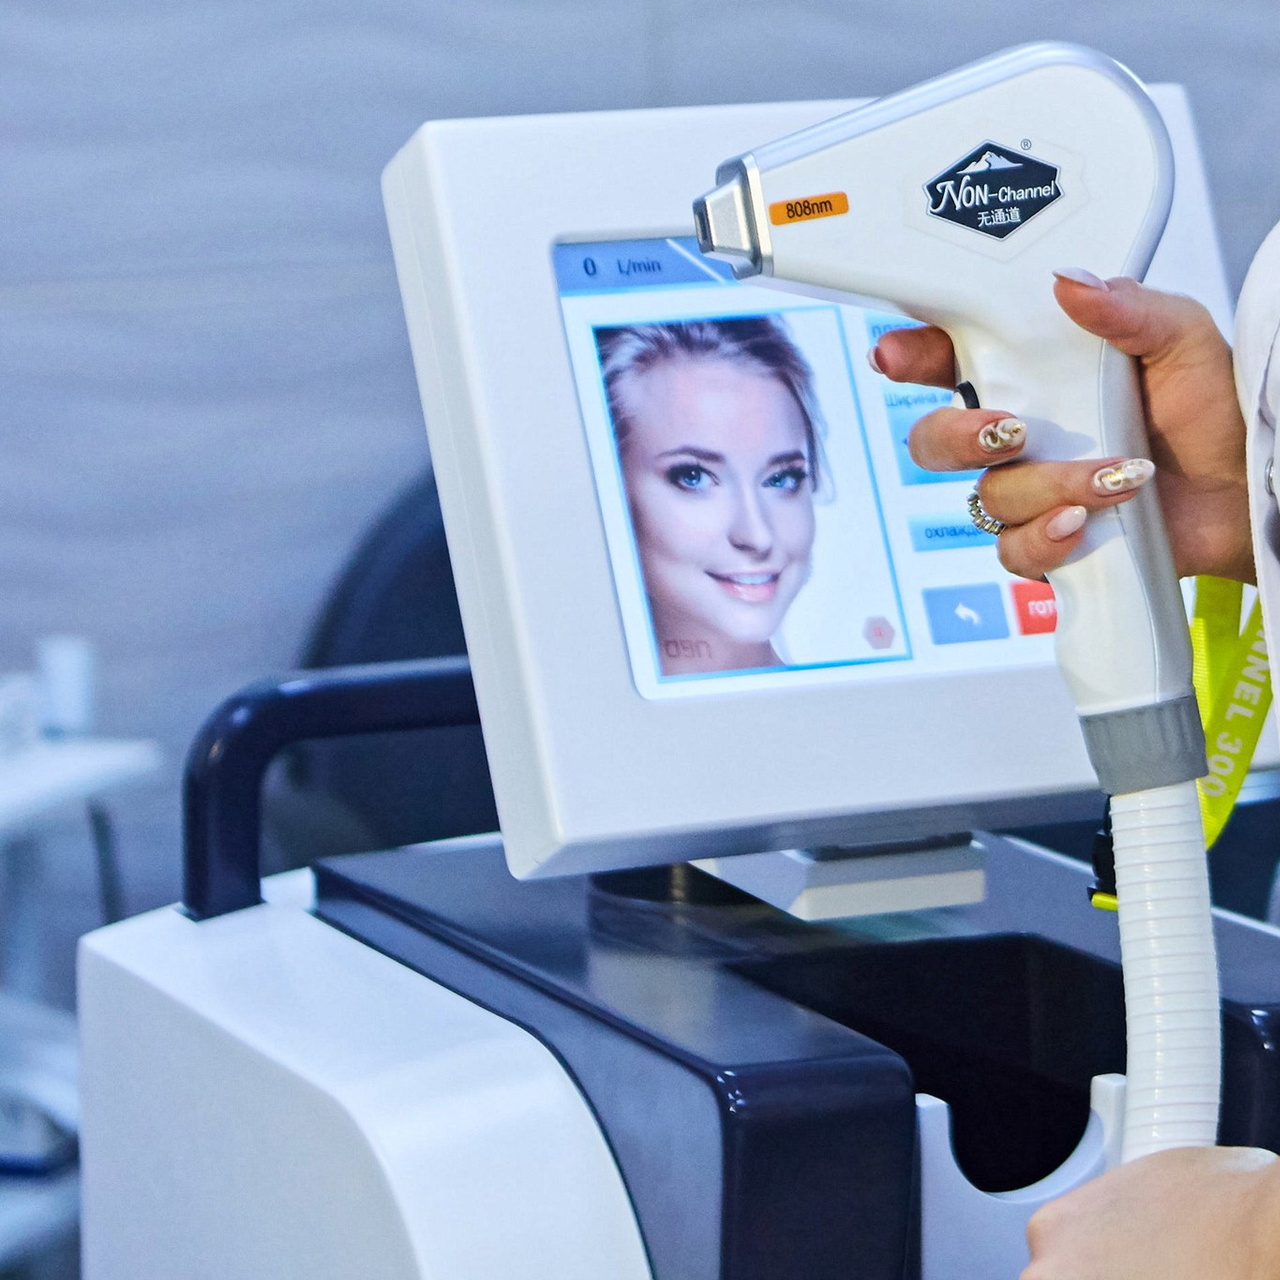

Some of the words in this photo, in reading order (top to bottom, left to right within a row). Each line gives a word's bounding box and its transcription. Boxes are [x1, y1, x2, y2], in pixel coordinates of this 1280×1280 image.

[786, 200, 833, 219] 808nm
[977, 207, 1021, 228] 无通道
[617, 257, 662, 276] L/min
[1202, 731, 1243, 798] 300
